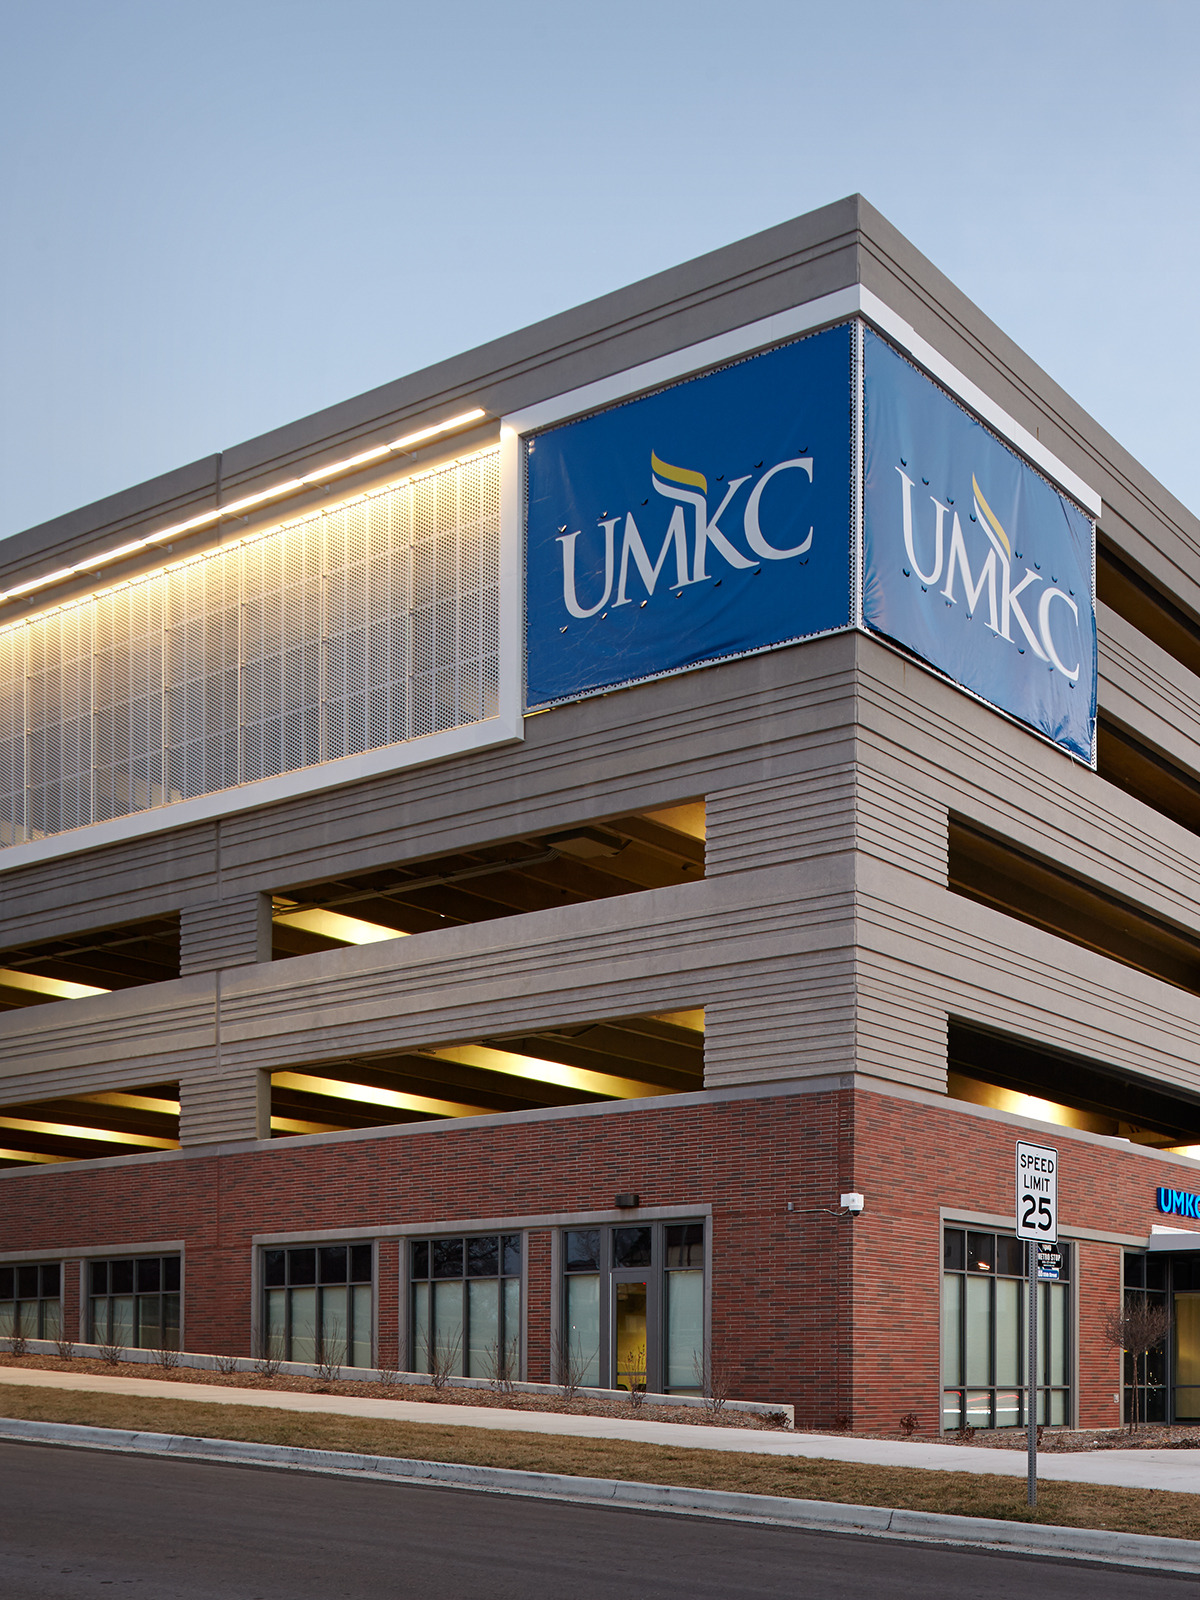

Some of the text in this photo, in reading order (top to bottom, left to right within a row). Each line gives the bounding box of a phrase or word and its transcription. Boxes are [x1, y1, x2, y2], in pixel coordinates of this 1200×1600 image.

[555, 450, 815, 620] UMKC
[894, 465, 1080, 682] UMKC
[1020, 1153, 1054, 1174] SPEED
[1023, 1174, 1050, 1192] LIMIT
[1022, 1194, 1052, 1231] 25
[1050, 1253, 1061, 1262] STOP
